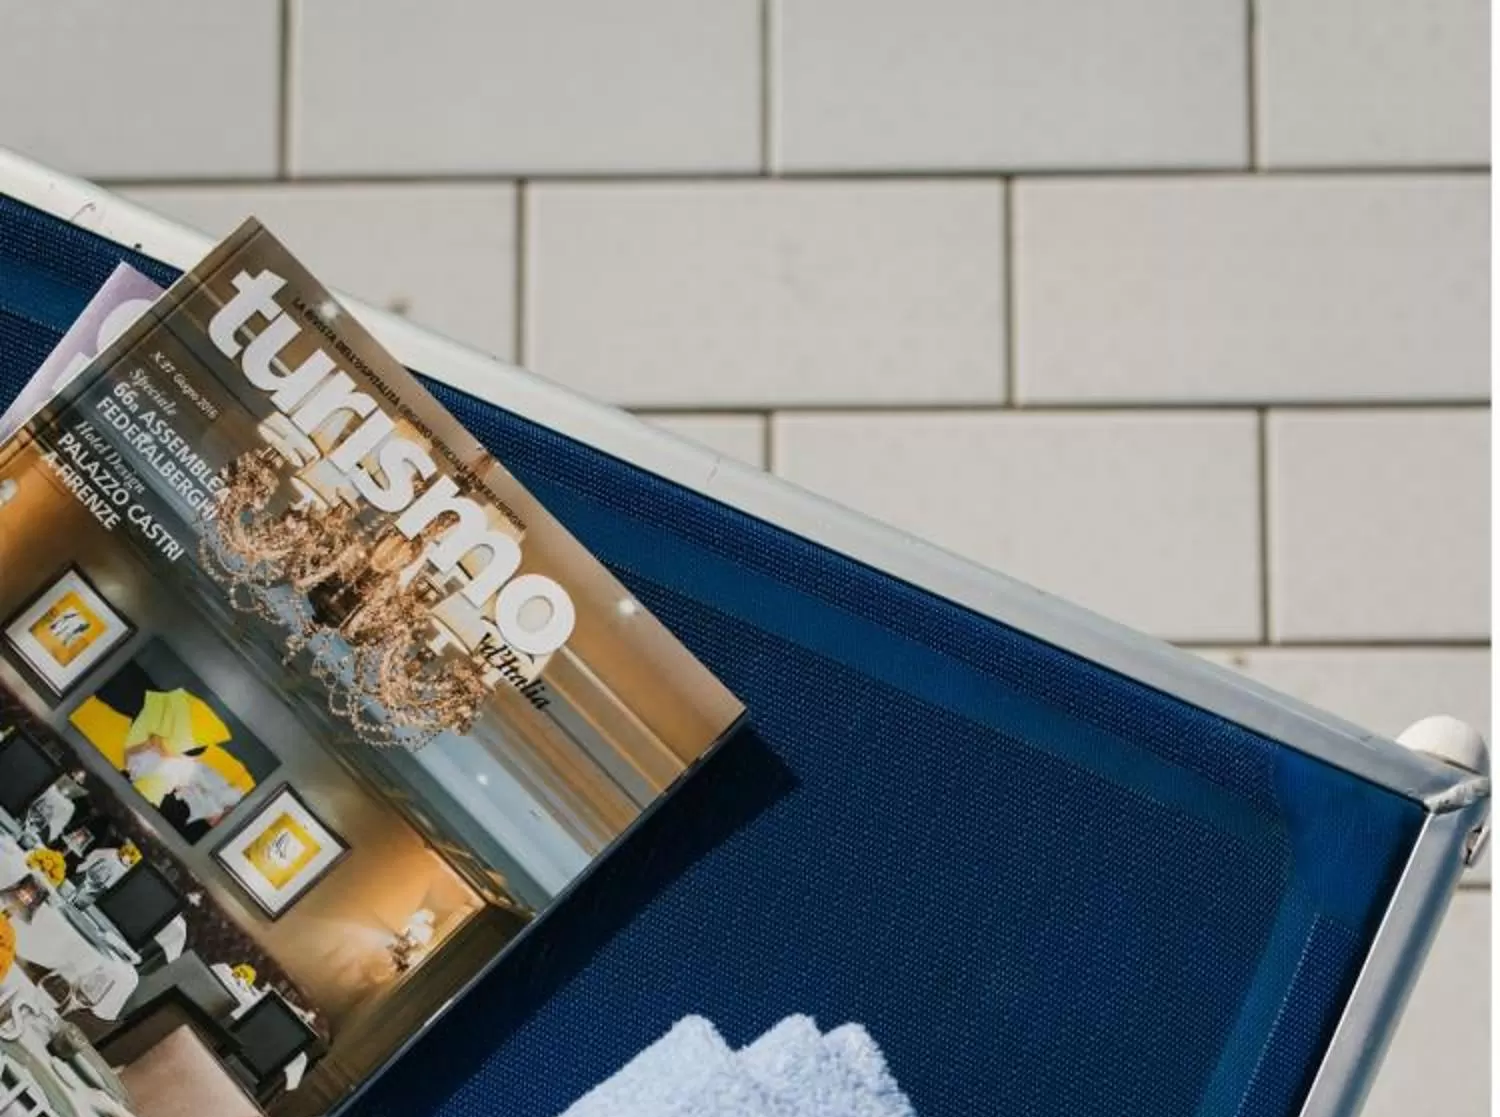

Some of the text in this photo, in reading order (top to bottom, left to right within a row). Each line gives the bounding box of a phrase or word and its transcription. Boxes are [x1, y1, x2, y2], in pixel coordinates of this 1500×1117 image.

[129, 368, 177, 416] Speciale
[41, 451, 122, 531] A FIRENZE
[57, 432, 130, 505] PALAZZO
[127, 504, 185, 563] CASTRI
[73, 421, 145, 495] Hotel Design
[95, 396, 219, 521] FEDERALBERGHI
[138, 410, 230, 503] ASSEMBLEA
[207, 268, 576, 656] turismo
